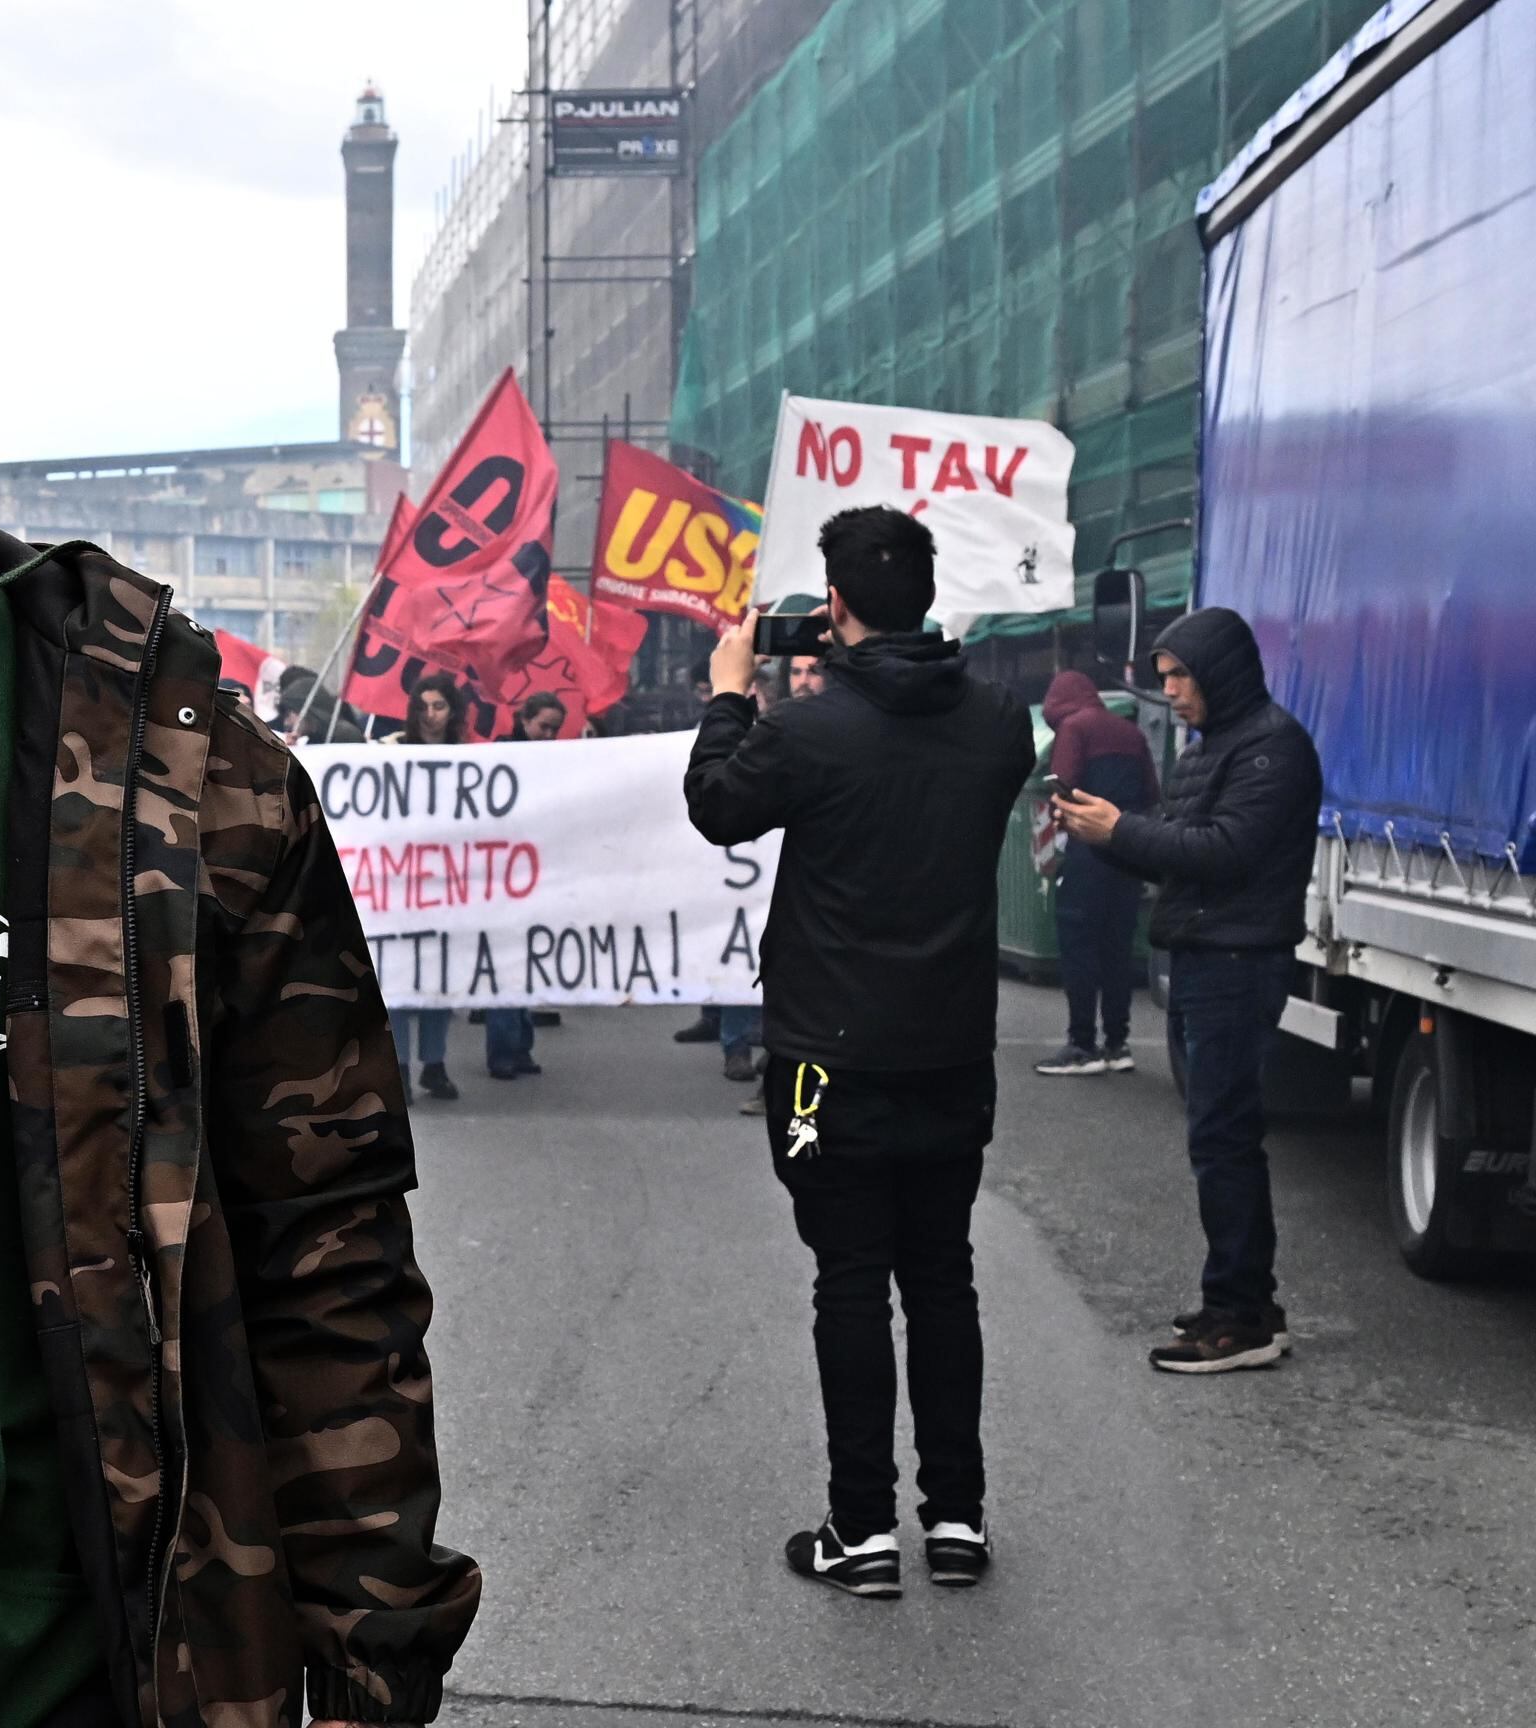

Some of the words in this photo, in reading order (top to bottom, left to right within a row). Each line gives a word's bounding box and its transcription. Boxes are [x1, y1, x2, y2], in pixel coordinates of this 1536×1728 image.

[796, 419, 863, 488] NO
[890, 434, 1028, 498] TAV
[321, 760, 520, 820] CONTRO
[469, 930, 499, 995] A
[525, 909, 681, 998] ROMA!
